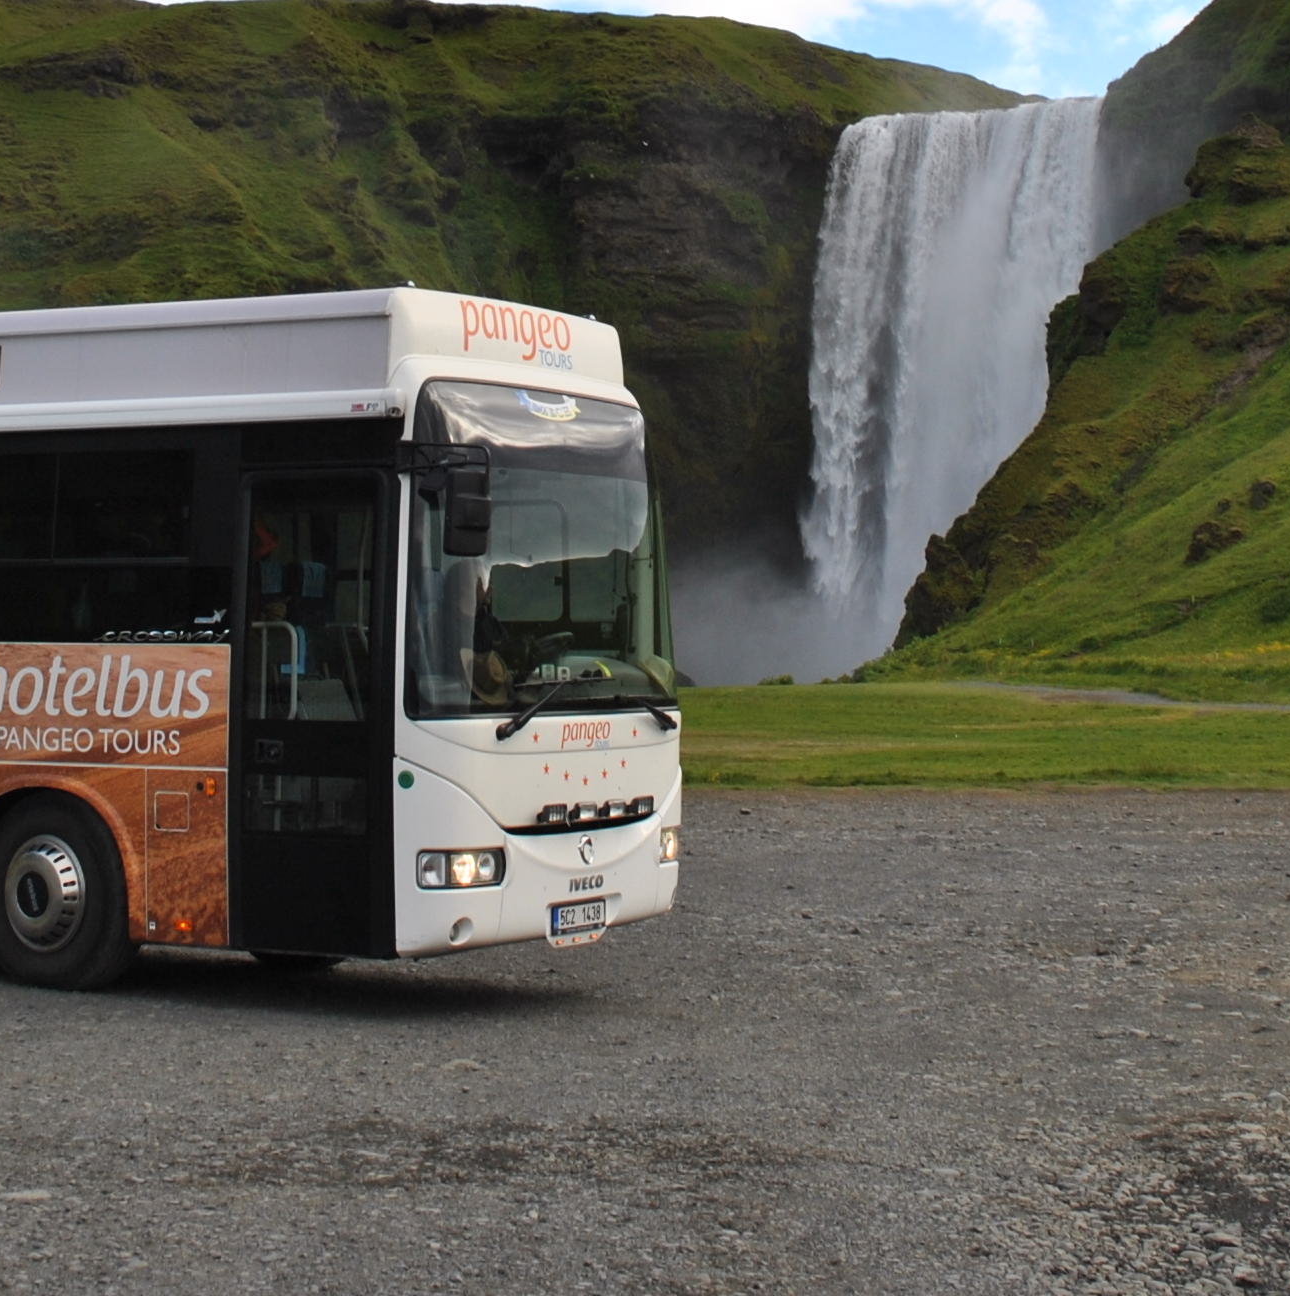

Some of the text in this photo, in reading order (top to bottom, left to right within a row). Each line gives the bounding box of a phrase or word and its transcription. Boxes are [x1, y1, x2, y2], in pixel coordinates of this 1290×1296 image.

[460, 300, 571, 361] pangeo
[538, 349, 573, 370] TOURS
[93, 628, 230, 643] CROSSWAY
[98, 728, 181, 755] TOURS
[561, 721, 611, 750] pangeo
[569, 874, 604, 893] IVECO
[582, 904, 601, 923] 1438
